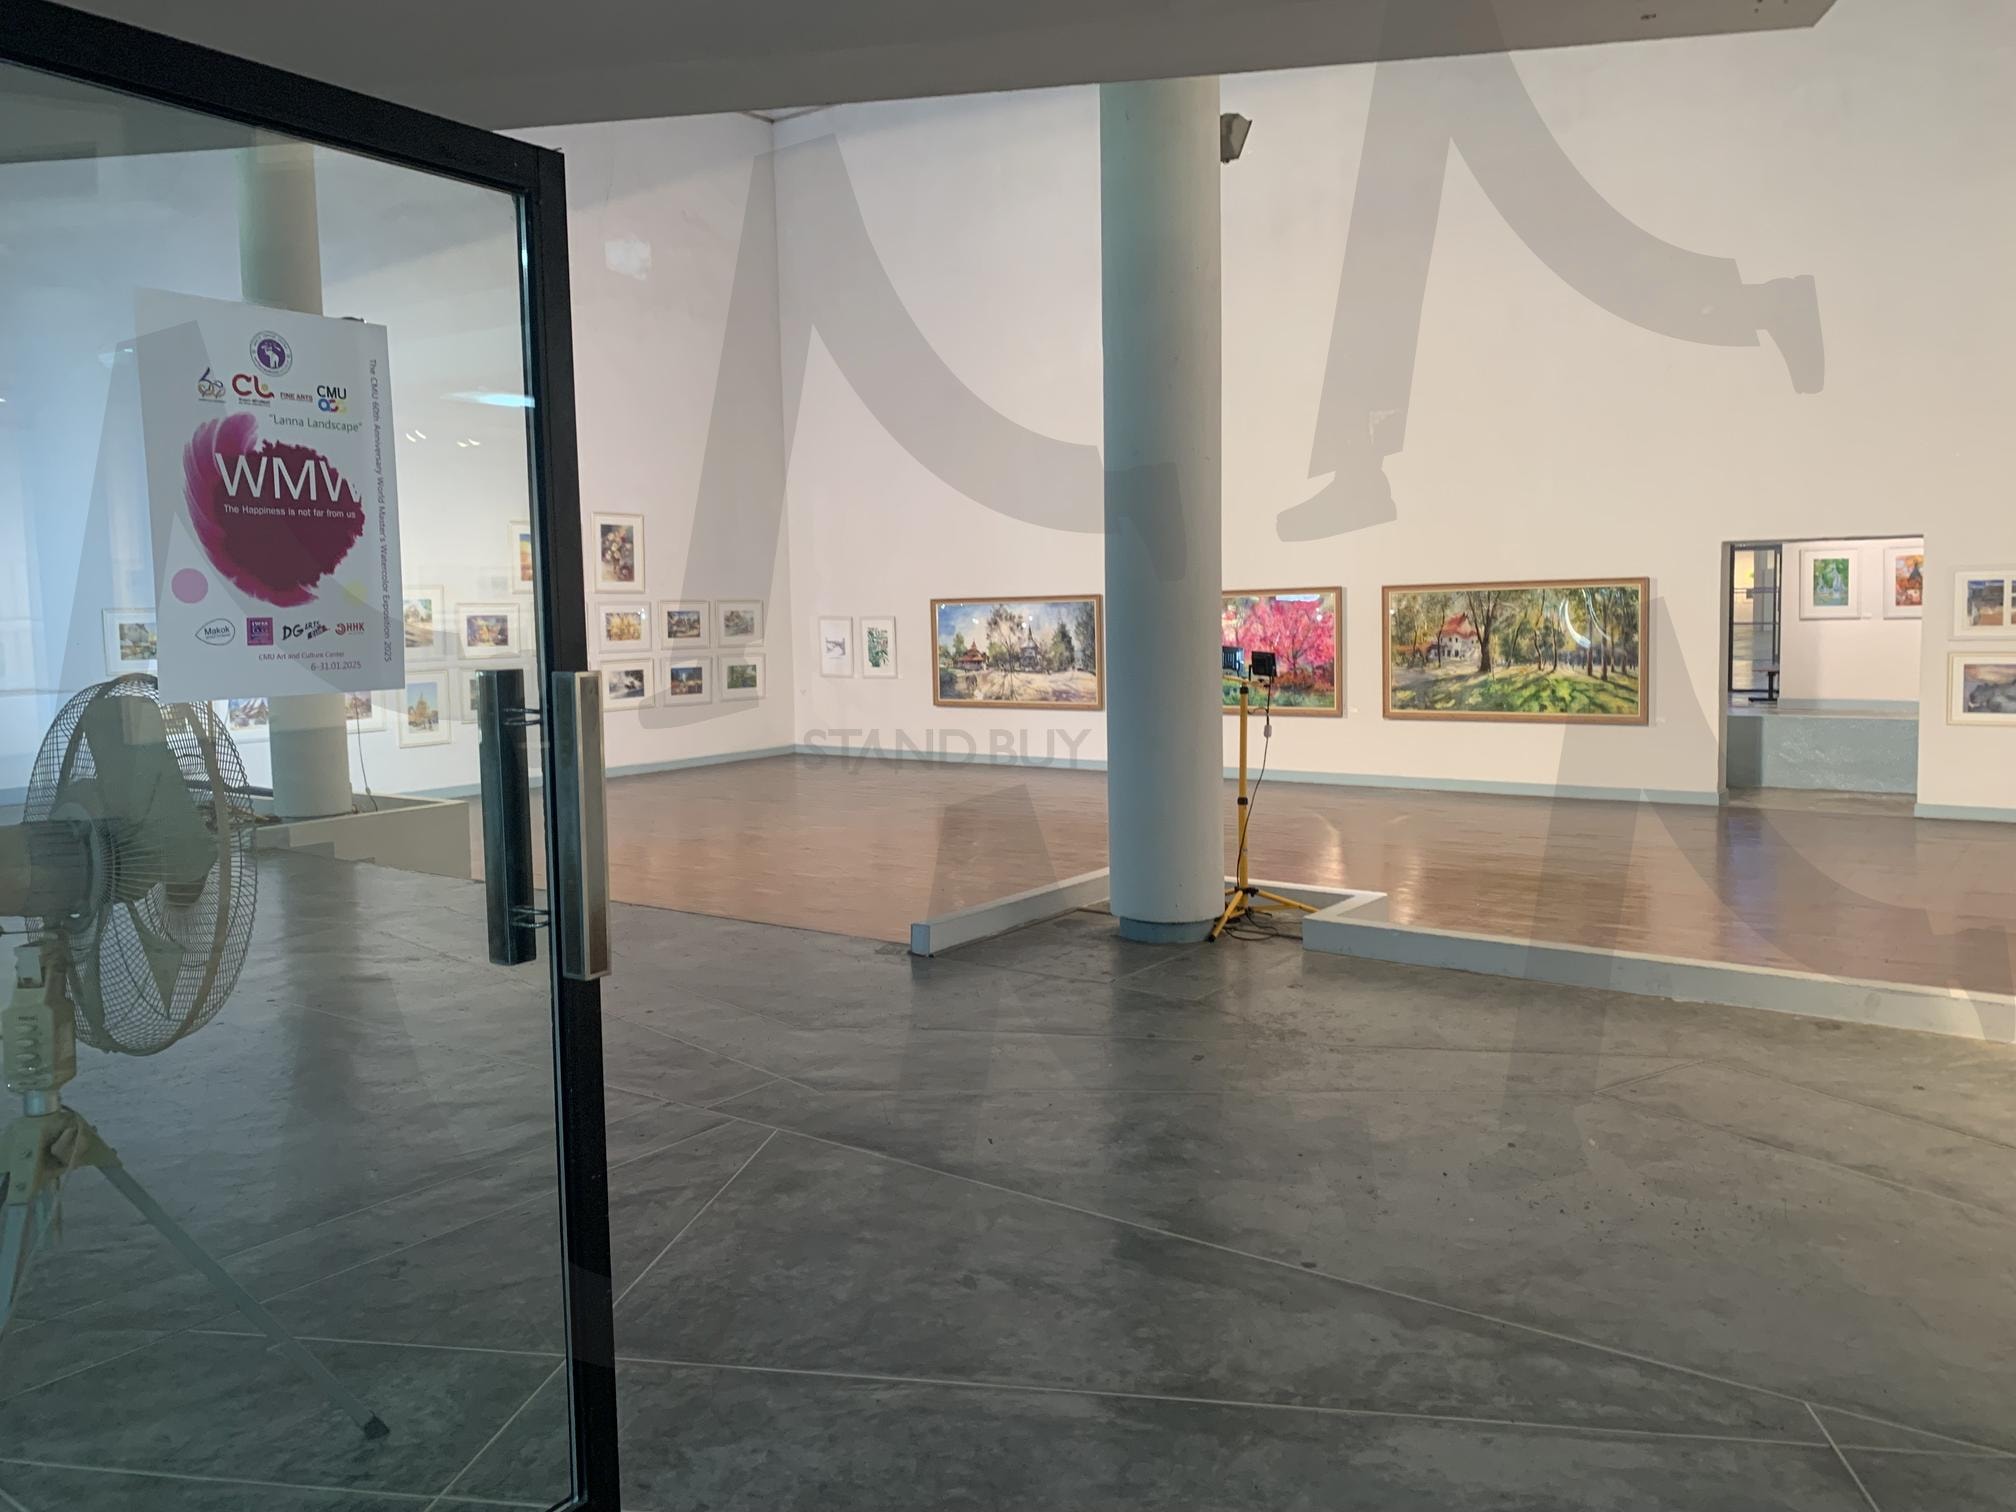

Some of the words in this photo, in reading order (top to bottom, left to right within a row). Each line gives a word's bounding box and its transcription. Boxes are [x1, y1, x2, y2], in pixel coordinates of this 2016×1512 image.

[369, 359, 377, 375] The
[316, 385, 347, 400] CMU
[370, 376, 379, 400] CMU
[377, 477, 385, 504] World
[224, 504, 240, 513] The
[242, 505, 286, 517] Happiness
[288, 507, 296, 516] is
[298, 508, 311, 517] not
[313, 508, 324, 517] far
[326, 508, 344, 518] from
[346, 511, 356, 519] us
[380, 544, 389, 592] Watercolor
[382, 594, 391, 640] Exposition
[203, 625, 231, 636] Makok
[276, 652, 287, 661] Art
[287, 651, 300, 660] and
[301, 650, 323, 659] Culture
[324, 649, 345, 658] Center
[384, 641, 392, 663] 2025
